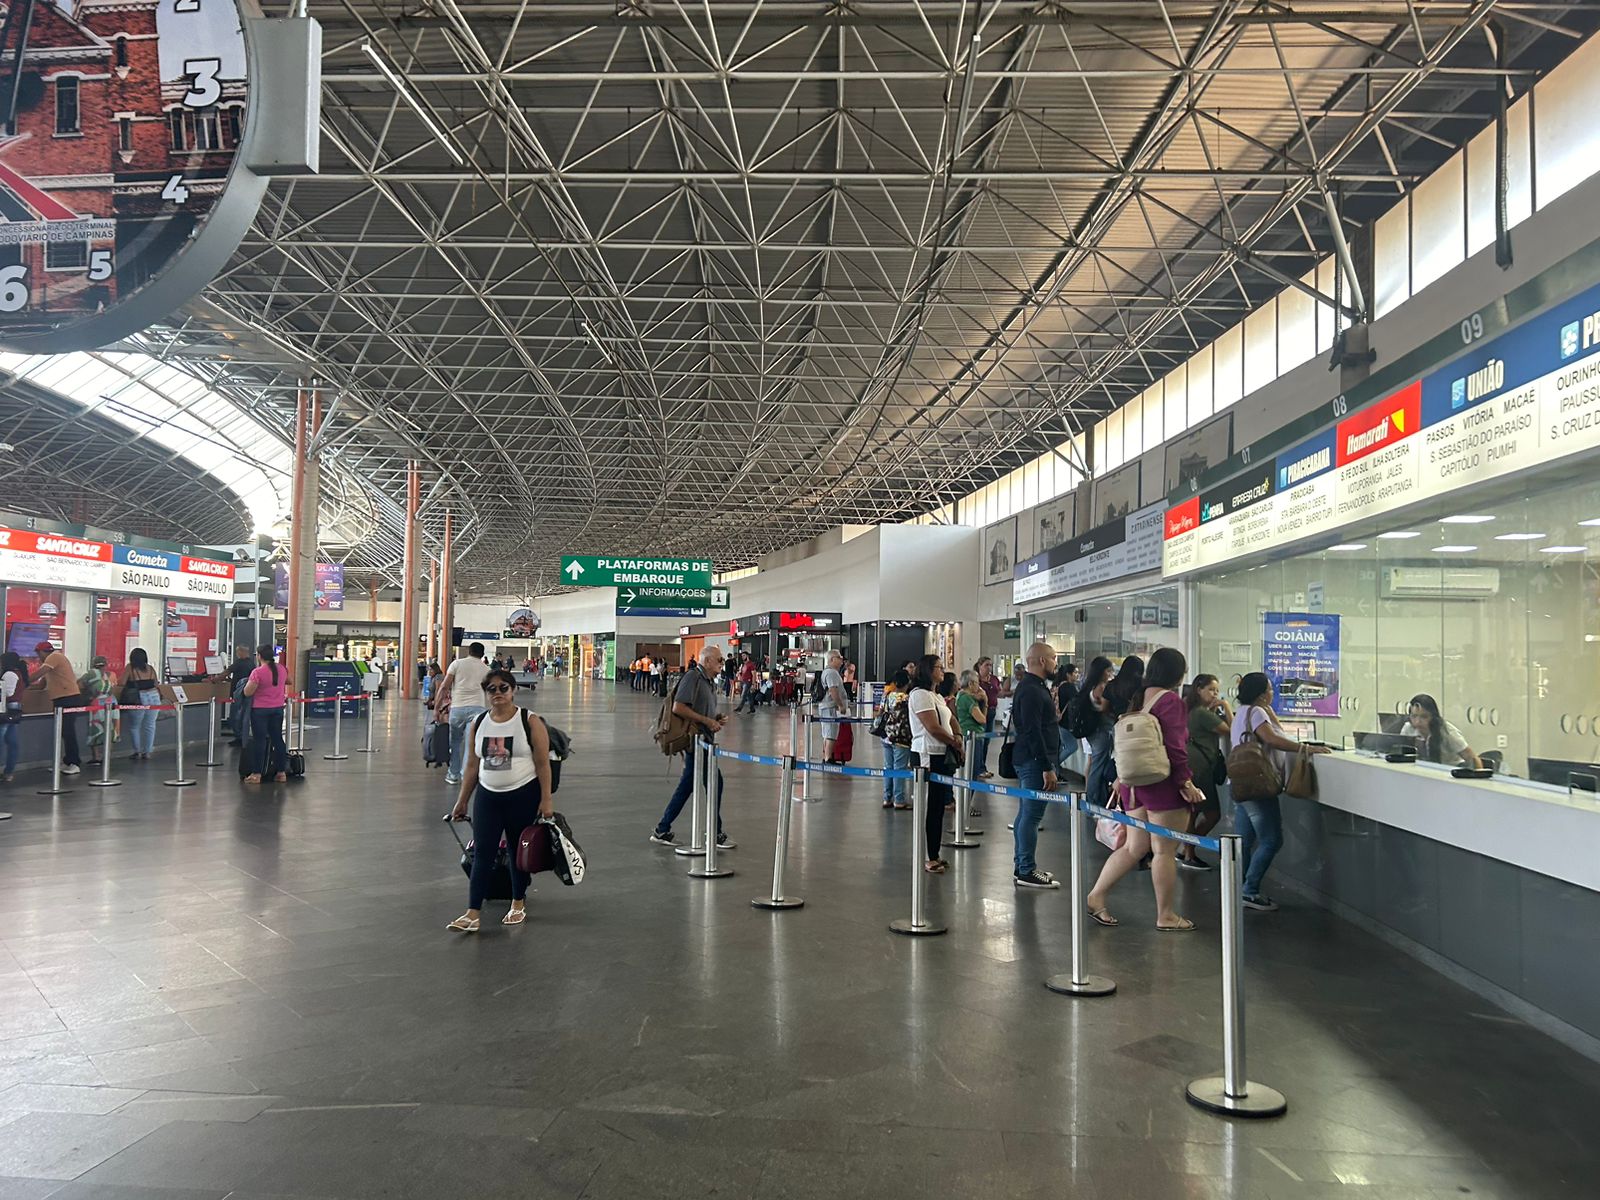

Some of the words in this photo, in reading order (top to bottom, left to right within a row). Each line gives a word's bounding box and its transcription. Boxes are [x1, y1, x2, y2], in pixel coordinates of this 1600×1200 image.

[184, 59, 222, 108] 3
[161, 174, 189, 204] 4
[52, 232, 63, 241] DE
[66, 230, 114, 240] CAMPINAS
[88, 250, 113, 281] 5
[0, 265, 28, 312] 6
[1461, 313, 1483, 345] 09
[1467, 358, 1504, 401] UNIÃO
[1332, 395, 1347, 418] 08
[1427, 423, 1454, 445] PASSOS
[1463, 406, 1494, 430] VITÓRIA
[1503, 387, 1535, 413] MACAÉ
[1563, 413, 1591, 436] CRUZ
[1438, 434, 1479, 460] SEBASTIÃO
[1480, 429, 1493, 445] DO
[1494, 413, 1532, 440] PARAÍSO
[1241, 447, 1251, 465] 07
[1440, 453, 1480, 478] CAPITÓLIO
[127, 550, 168, 568] Cometa
[597, 559, 689, 571] PLATAFORMAS
[692, 562, 709, 572] DE
[122, 569, 141, 585] SÃO
[143, 573, 170, 588] PAULO
[188, 578, 203, 592] SÃO
[205, 583, 227, 594] PAULO
[613, 573, 684, 584] EMBARQUE
[1275, 629, 1325, 642] GOIÂNIA
